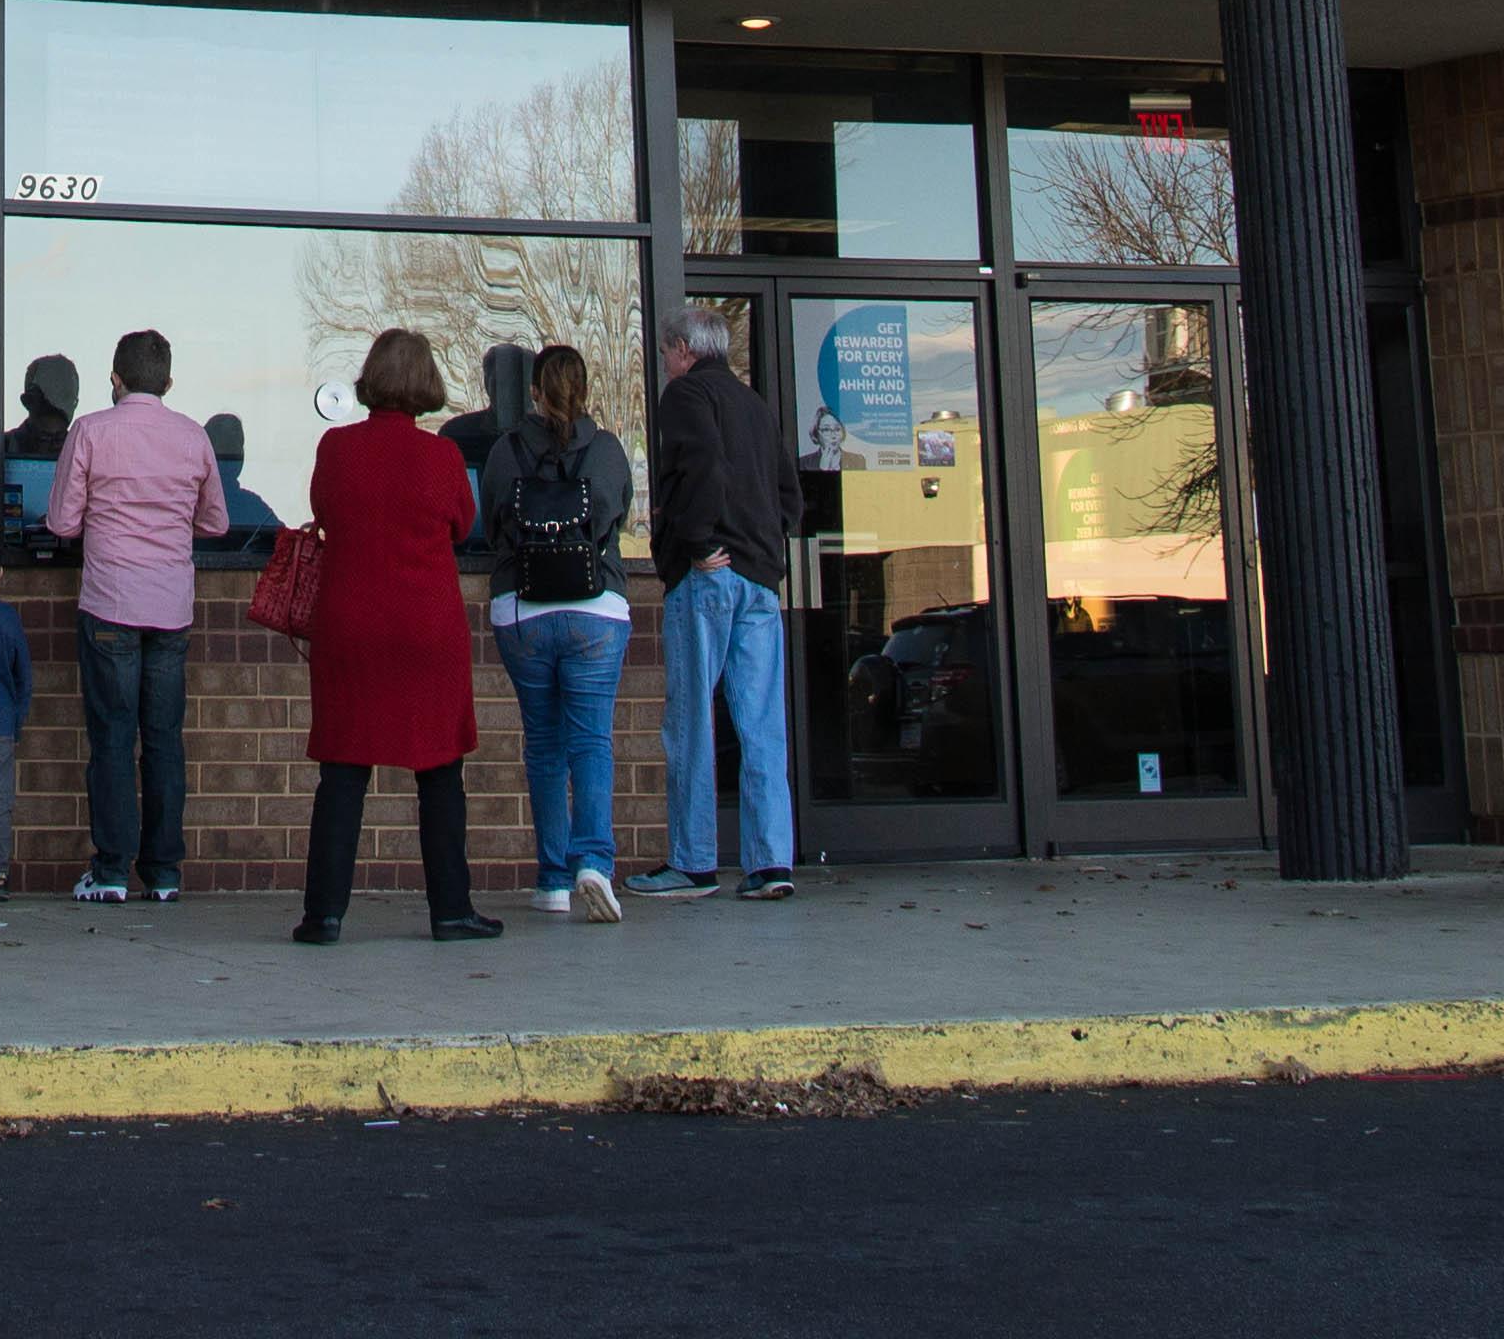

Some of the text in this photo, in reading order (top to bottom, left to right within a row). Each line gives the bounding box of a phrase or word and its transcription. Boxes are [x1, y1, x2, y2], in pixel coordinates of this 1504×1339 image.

[18, 175, 98, 200] 9630
[877, 323, 902, 335] GET
[834, 336, 903, 348] REWARDED
[837, 350, 904, 363] FOR EVERY
[861, 365, 904, 378] OOOH,
[838, 380, 905, 391] AHHH AND
[862, 394, 906, 405] WHOA.
